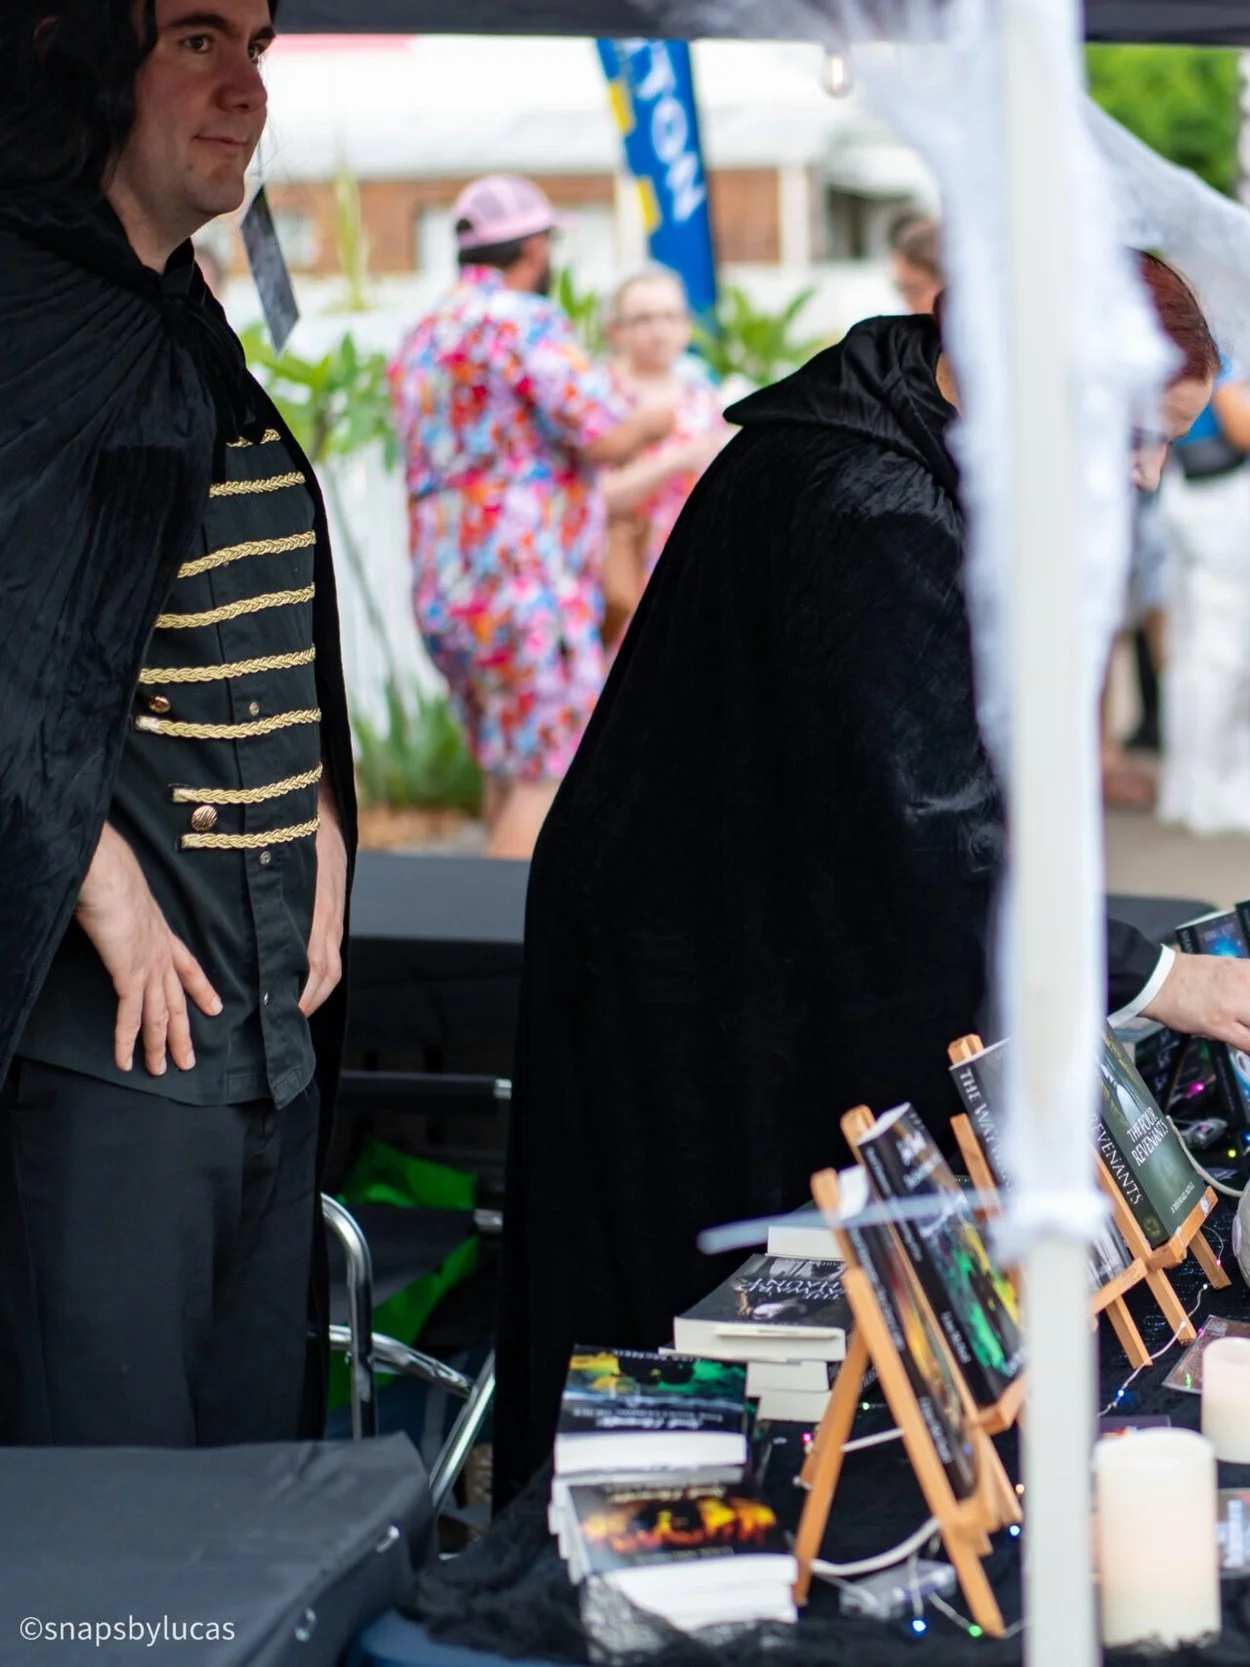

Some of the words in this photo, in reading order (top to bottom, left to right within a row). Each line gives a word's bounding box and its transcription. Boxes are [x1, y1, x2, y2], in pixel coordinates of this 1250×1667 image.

[960, 1067, 982, 1102] THE
[1138, 1106, 1158, 1133] FOUR
[1131, 1118, 1169, 1166] REVENANTS
